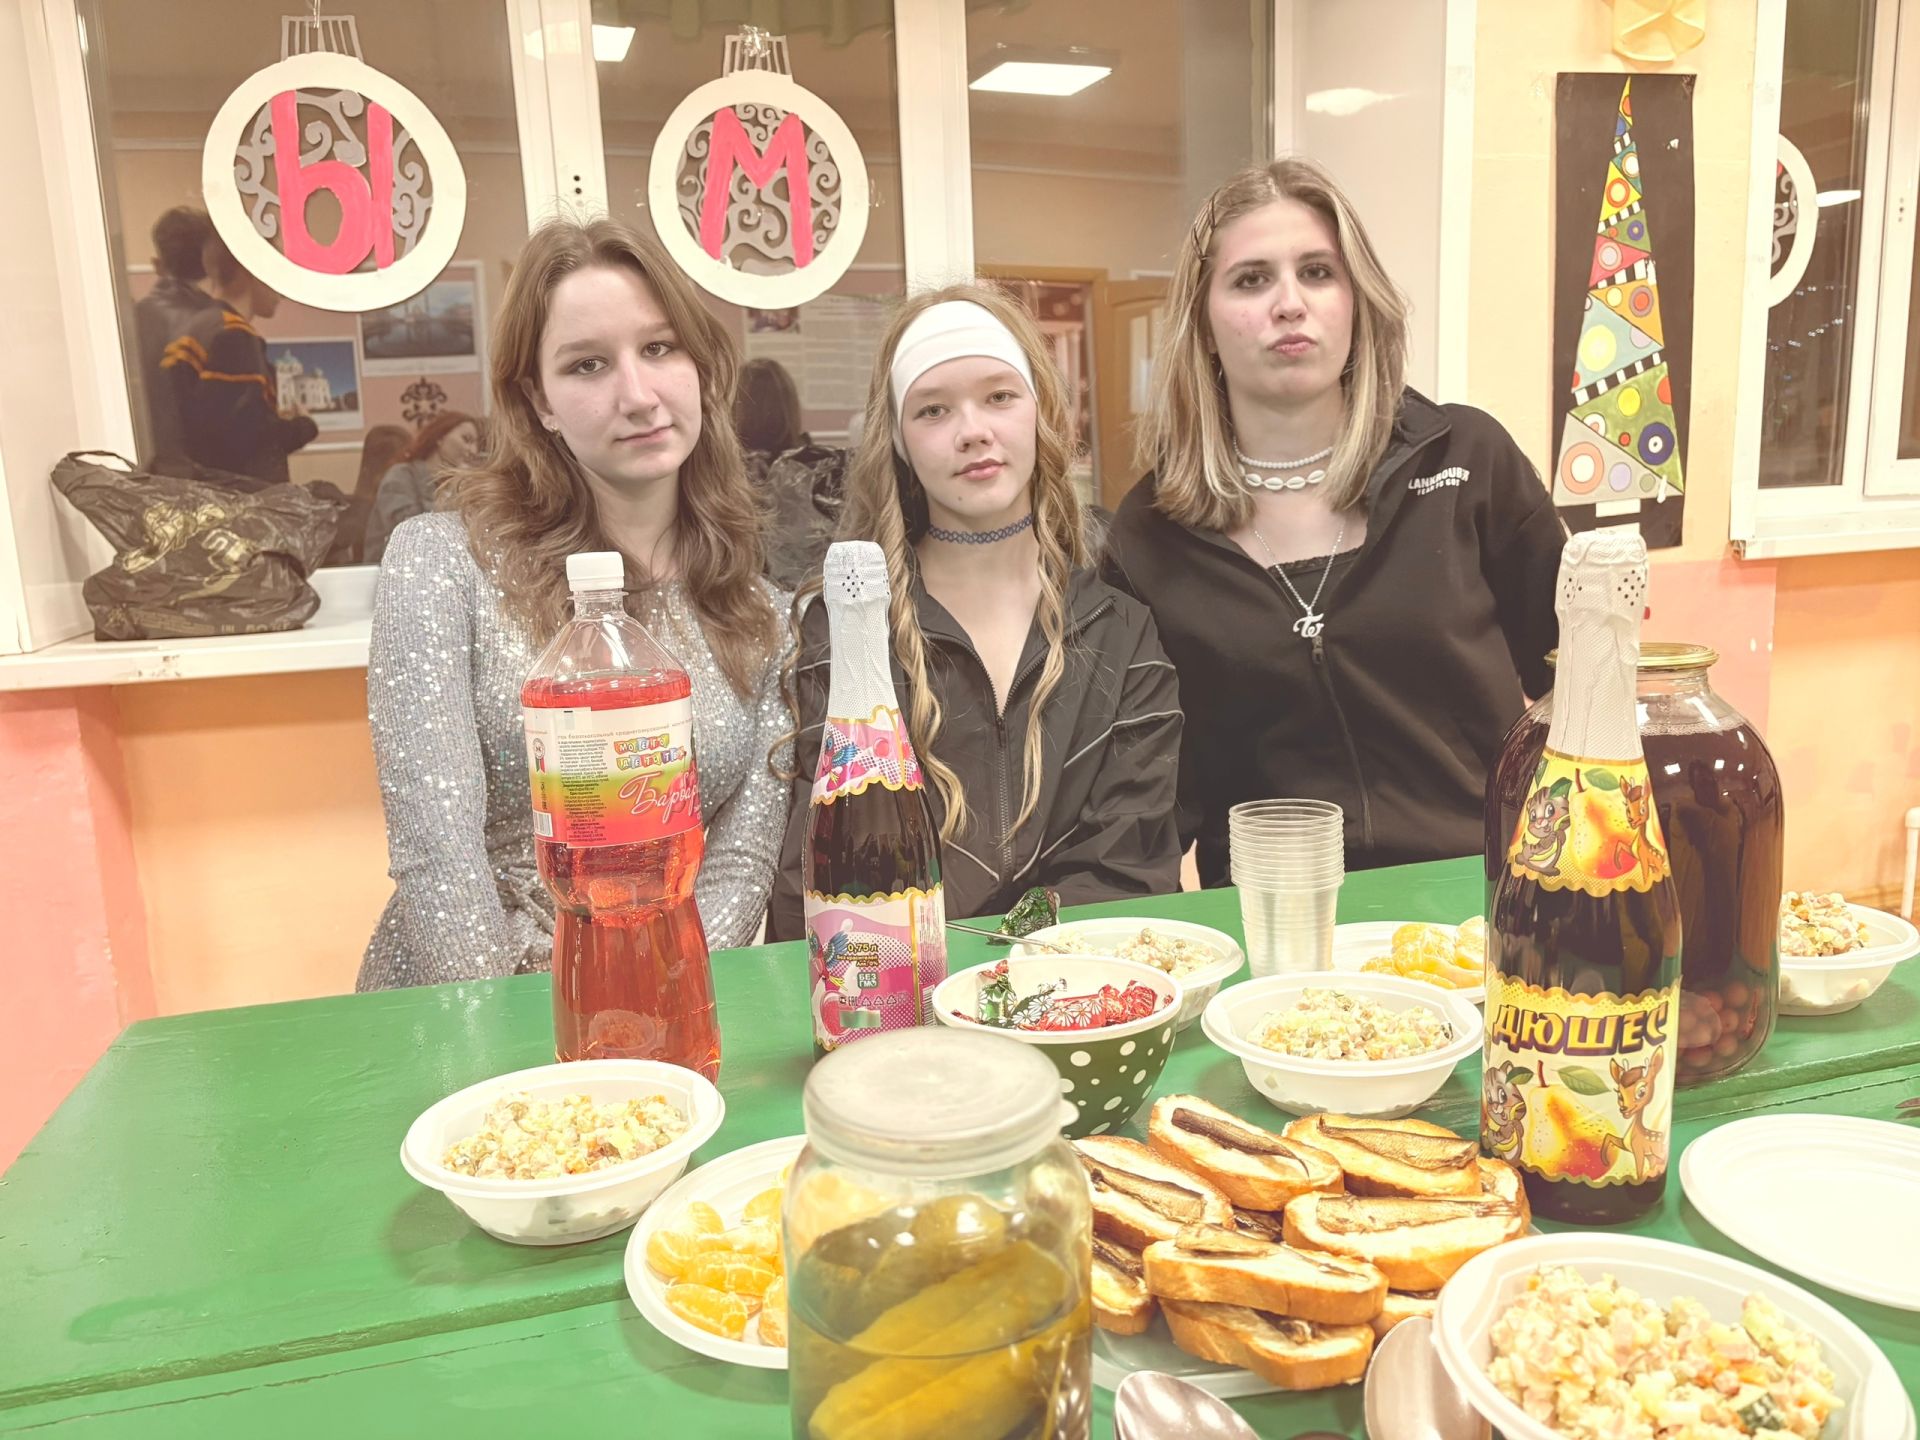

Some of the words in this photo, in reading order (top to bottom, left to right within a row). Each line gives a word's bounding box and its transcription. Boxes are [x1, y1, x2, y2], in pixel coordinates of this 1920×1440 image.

[270, 90, 395, 274] Ы
[699, 107, 813, 269] М
[847, 943, 869, 954] 0,75
[1492, 1001, 1669, 1056] ДЮШЕС
